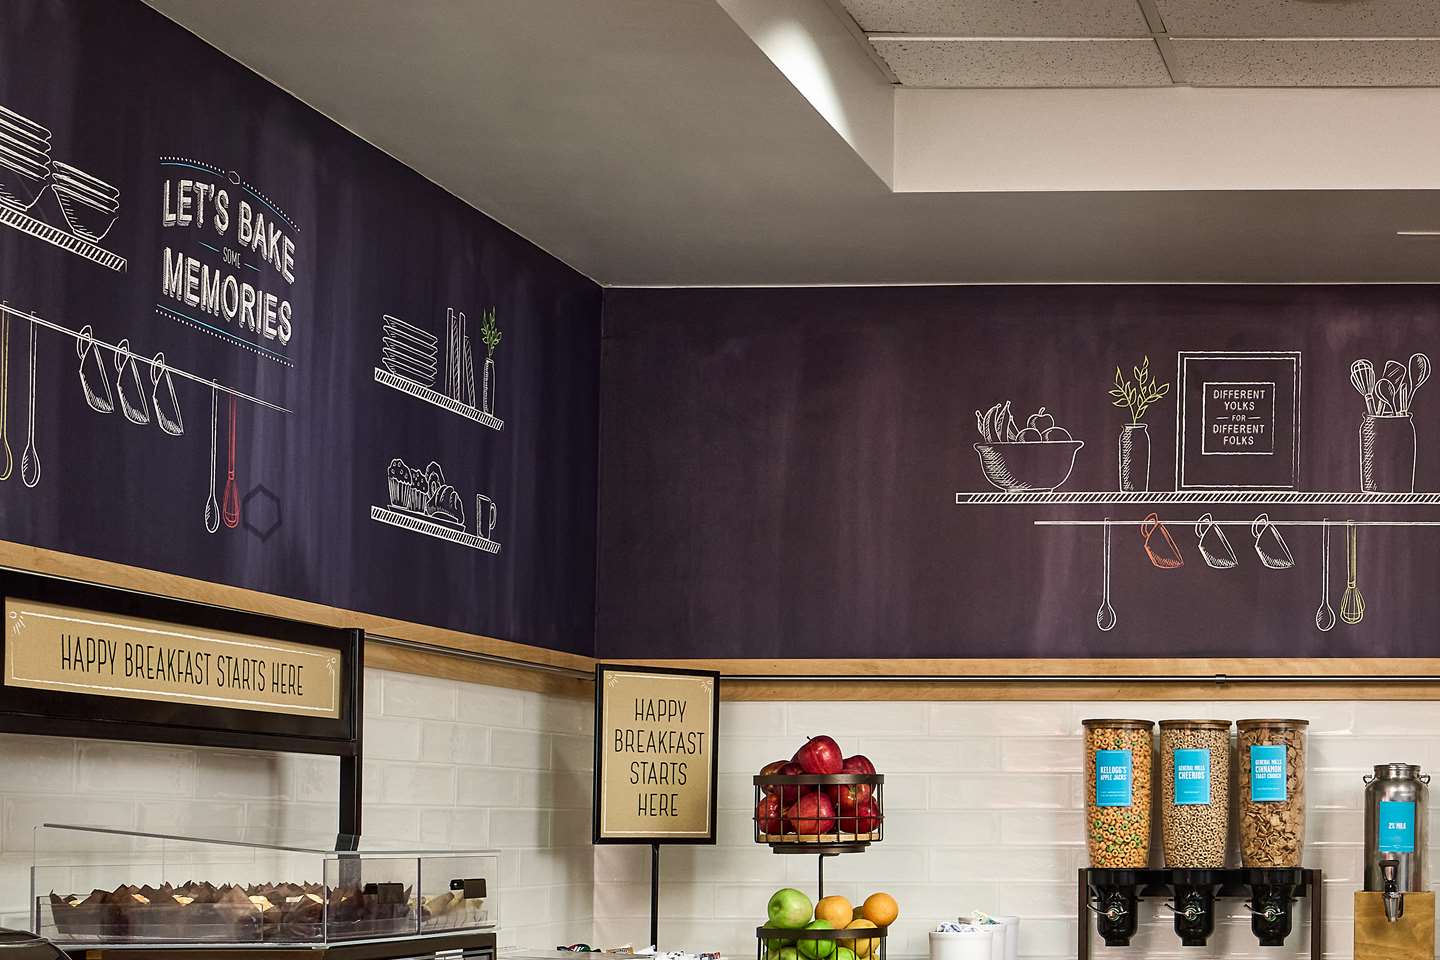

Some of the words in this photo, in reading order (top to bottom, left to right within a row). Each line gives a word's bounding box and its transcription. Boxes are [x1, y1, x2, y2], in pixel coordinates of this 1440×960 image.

[163, 179, 229, 236] LET'S
[237, 200, 295, 285] BAKE
[222, 246, 241, 269] SOME
[162, 246, 292, 346] MEMORIES
[1213, 389, 1266, 399] DIFFERENT
[1224, 401, 1256, 411] YOLKS
[1212, 424, 1265, 434] DIFFERENT
[1231, 414, 1246, 422] FOR
[1223, 435, 1254, 445] FOLKS
[61, 633, 117, 675] HAPPY
[124, 642, 211, 686] BREAKFAST
[216, 654, 266, 692] STARTS
[271, 661, 304, 696] HERE
[634, 698, 687, 723] HAPPY
[615, 728, 705, 755] BREAKFAST
[630, 761, 688, 785] STARTS
[638, 793, 679, 817] HERE
